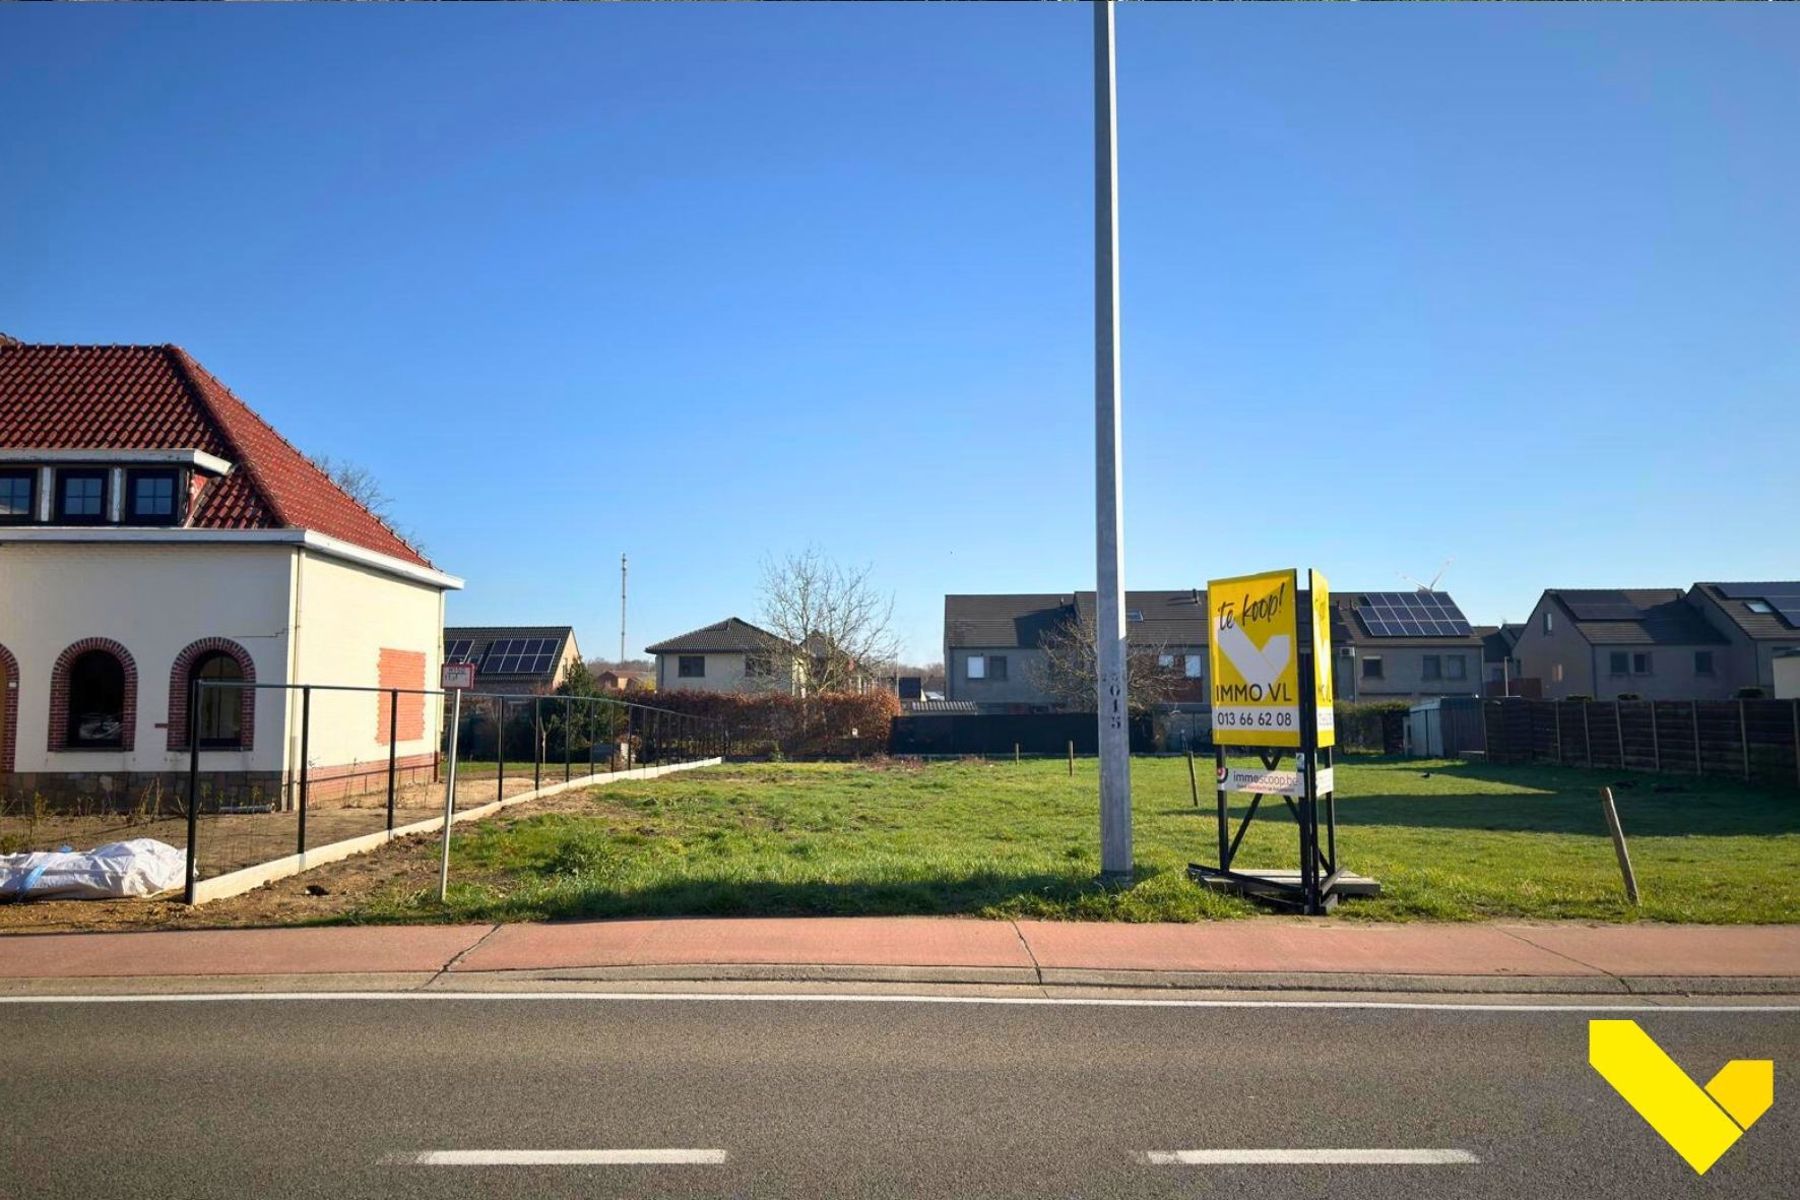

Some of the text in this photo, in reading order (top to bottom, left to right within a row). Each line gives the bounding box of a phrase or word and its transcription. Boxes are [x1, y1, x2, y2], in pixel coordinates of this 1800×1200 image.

[1217, 601, 1235, 630] te
[1242, 582, 1285, 626] koop!
[1216, 683, 1292, 702] IMMO VL
[1217, 712, 1292, 726] 013 66 62 08
